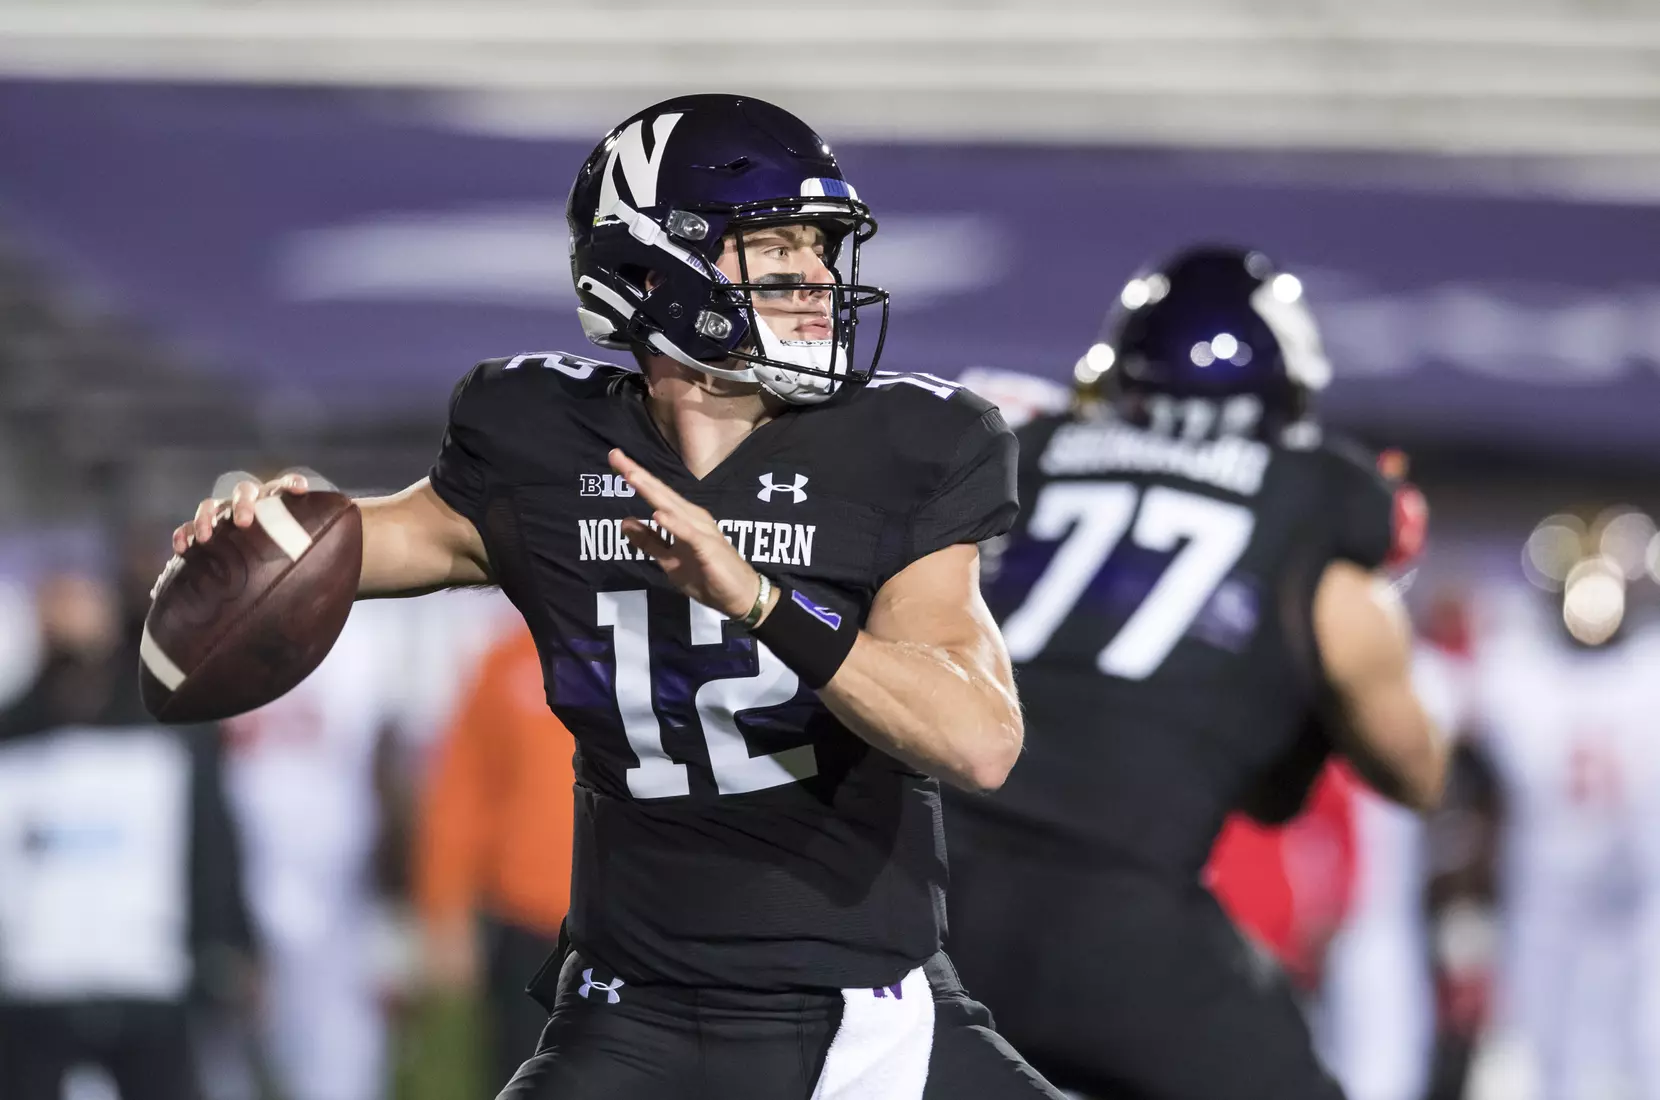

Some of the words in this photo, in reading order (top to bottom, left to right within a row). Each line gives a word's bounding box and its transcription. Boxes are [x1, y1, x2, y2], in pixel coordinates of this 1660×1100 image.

[598, 112, 684, 218] N
[577, 518, 817, 567] NORSTERN
[1001, 480, 1256, 681] 77
[596, 589, 819, 800] 12
